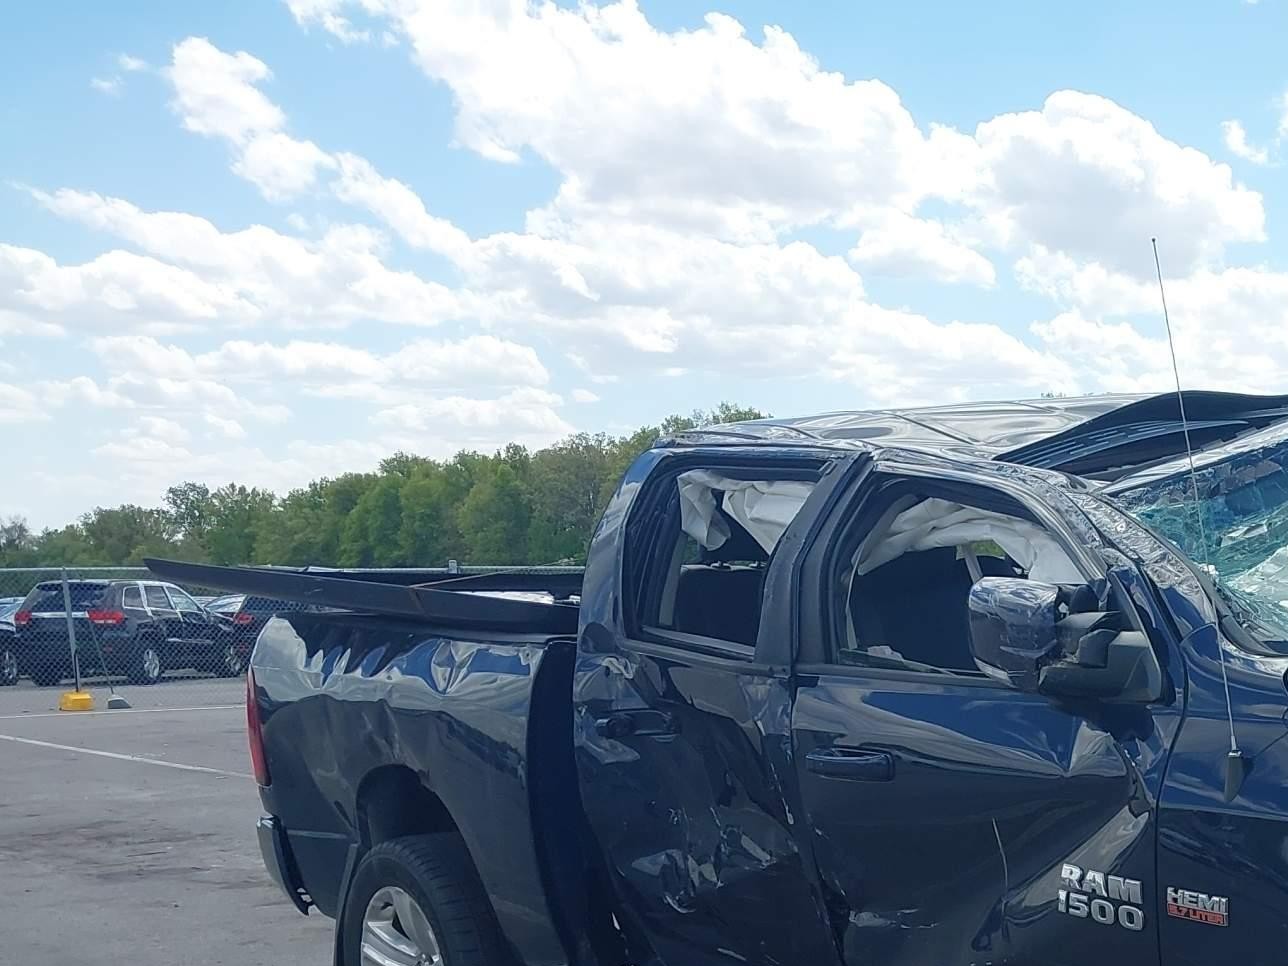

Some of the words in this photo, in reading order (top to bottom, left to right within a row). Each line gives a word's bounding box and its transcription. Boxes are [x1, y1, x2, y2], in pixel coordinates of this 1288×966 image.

[1060, 863, 1143, 904] RAM
[1167, 887, 1229, 914] HEMI
[1057, 889, 1145, 931] 1500
[1189, 908, 1225, 925] LITER
